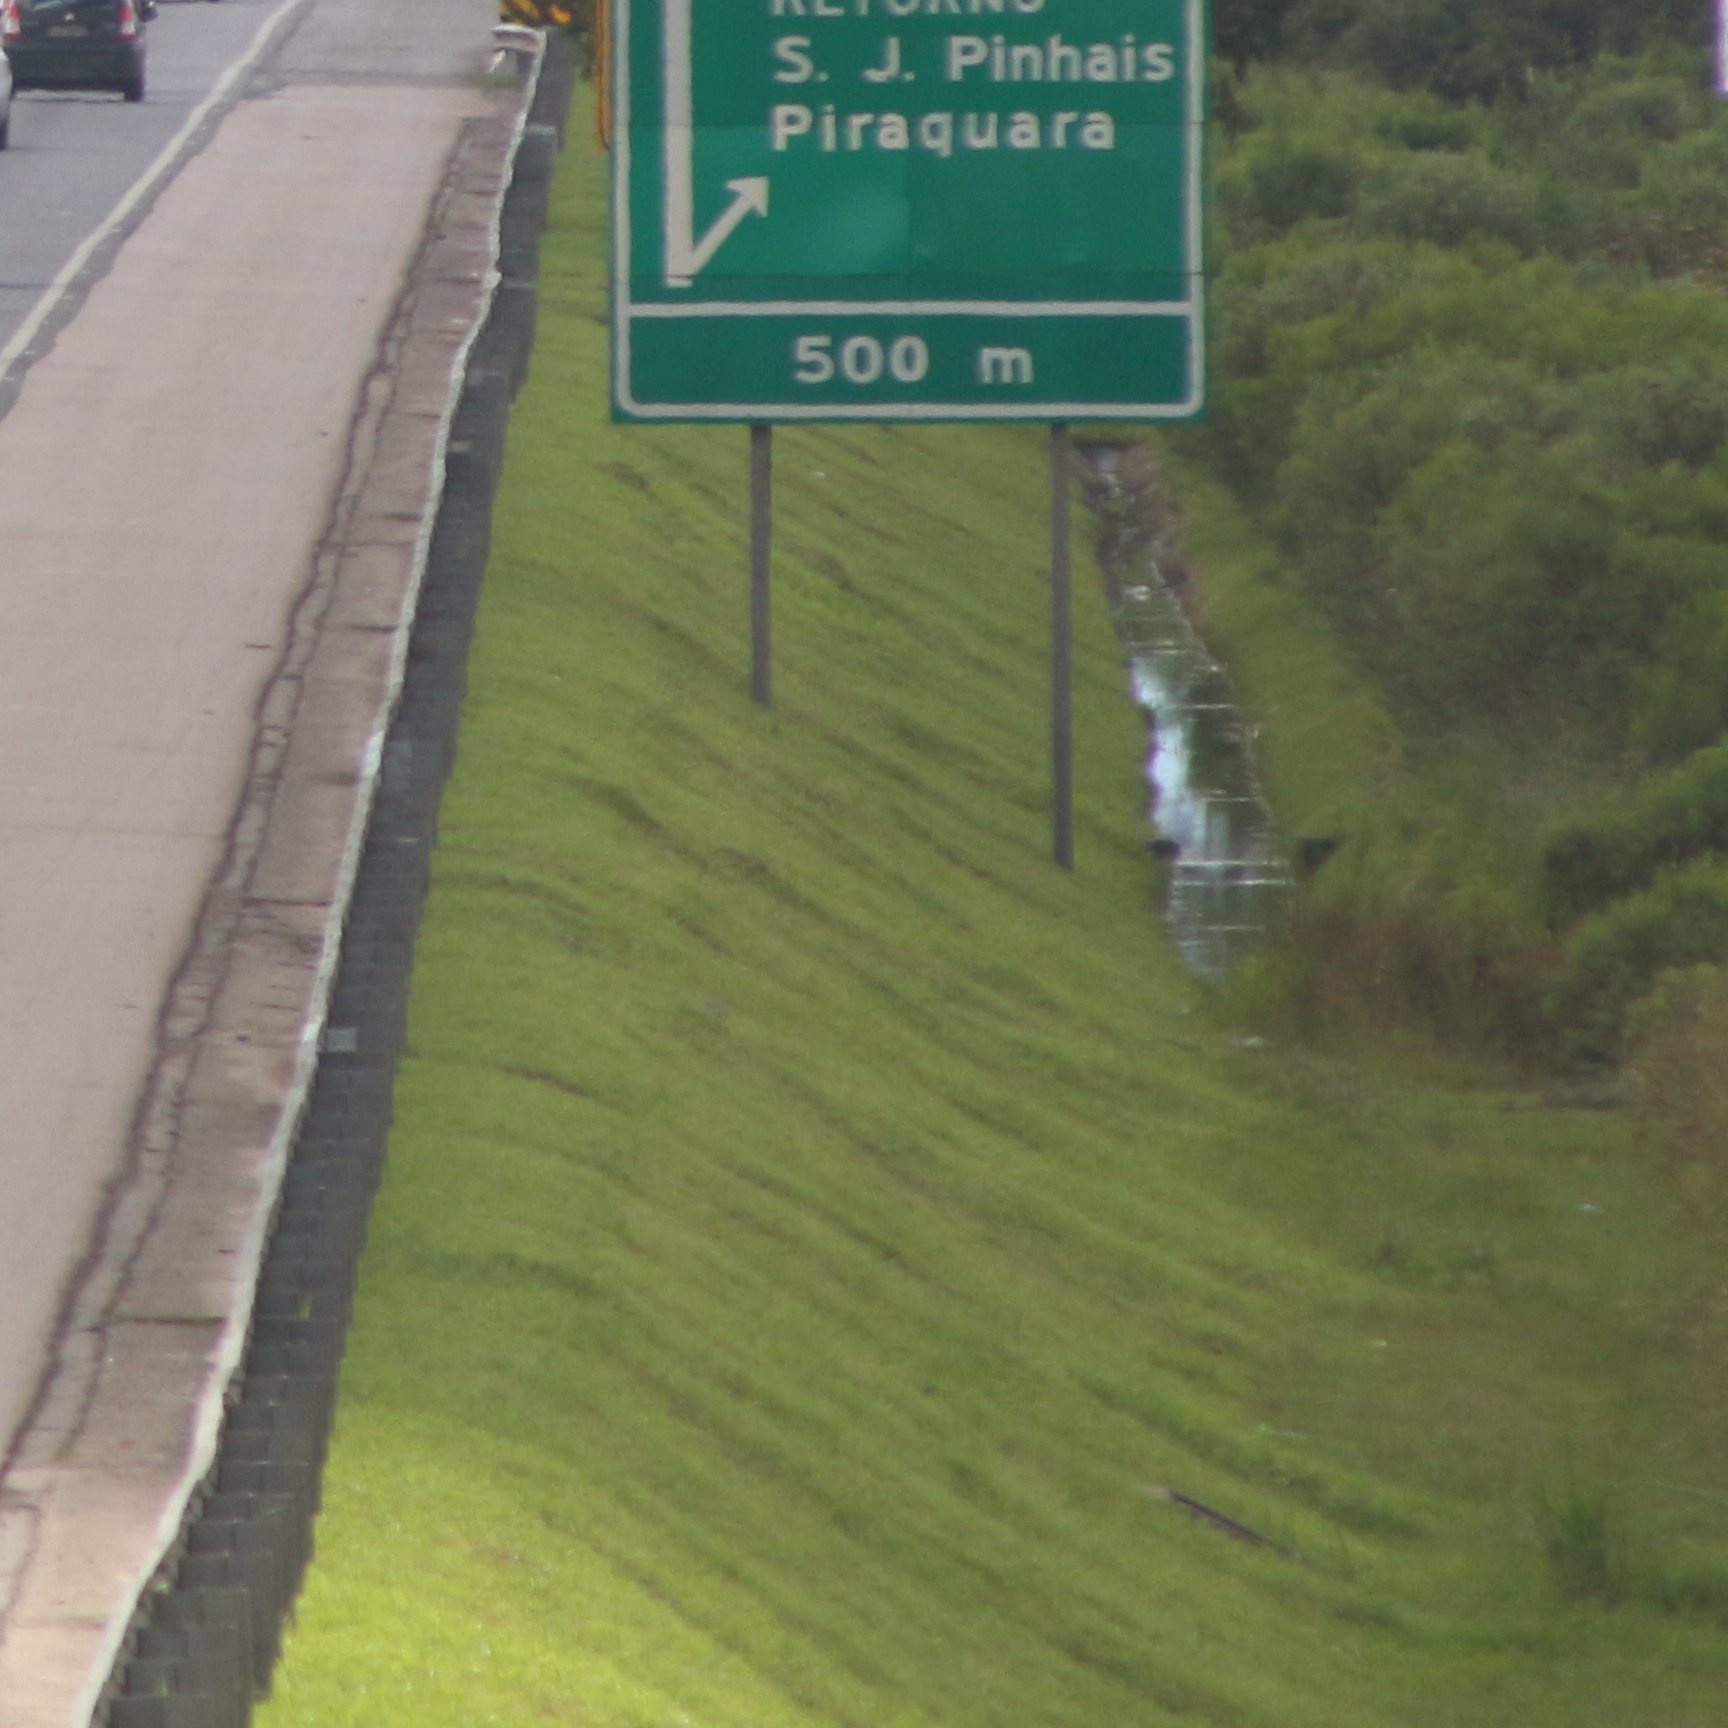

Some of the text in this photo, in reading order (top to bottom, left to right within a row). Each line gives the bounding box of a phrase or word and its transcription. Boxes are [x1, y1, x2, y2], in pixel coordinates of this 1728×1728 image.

[773, 34, 1174, 84] S. J. Pinhais
[771, 104, 1116, 158] Piraquara
[793, 334, 1033, 384] 500 m
